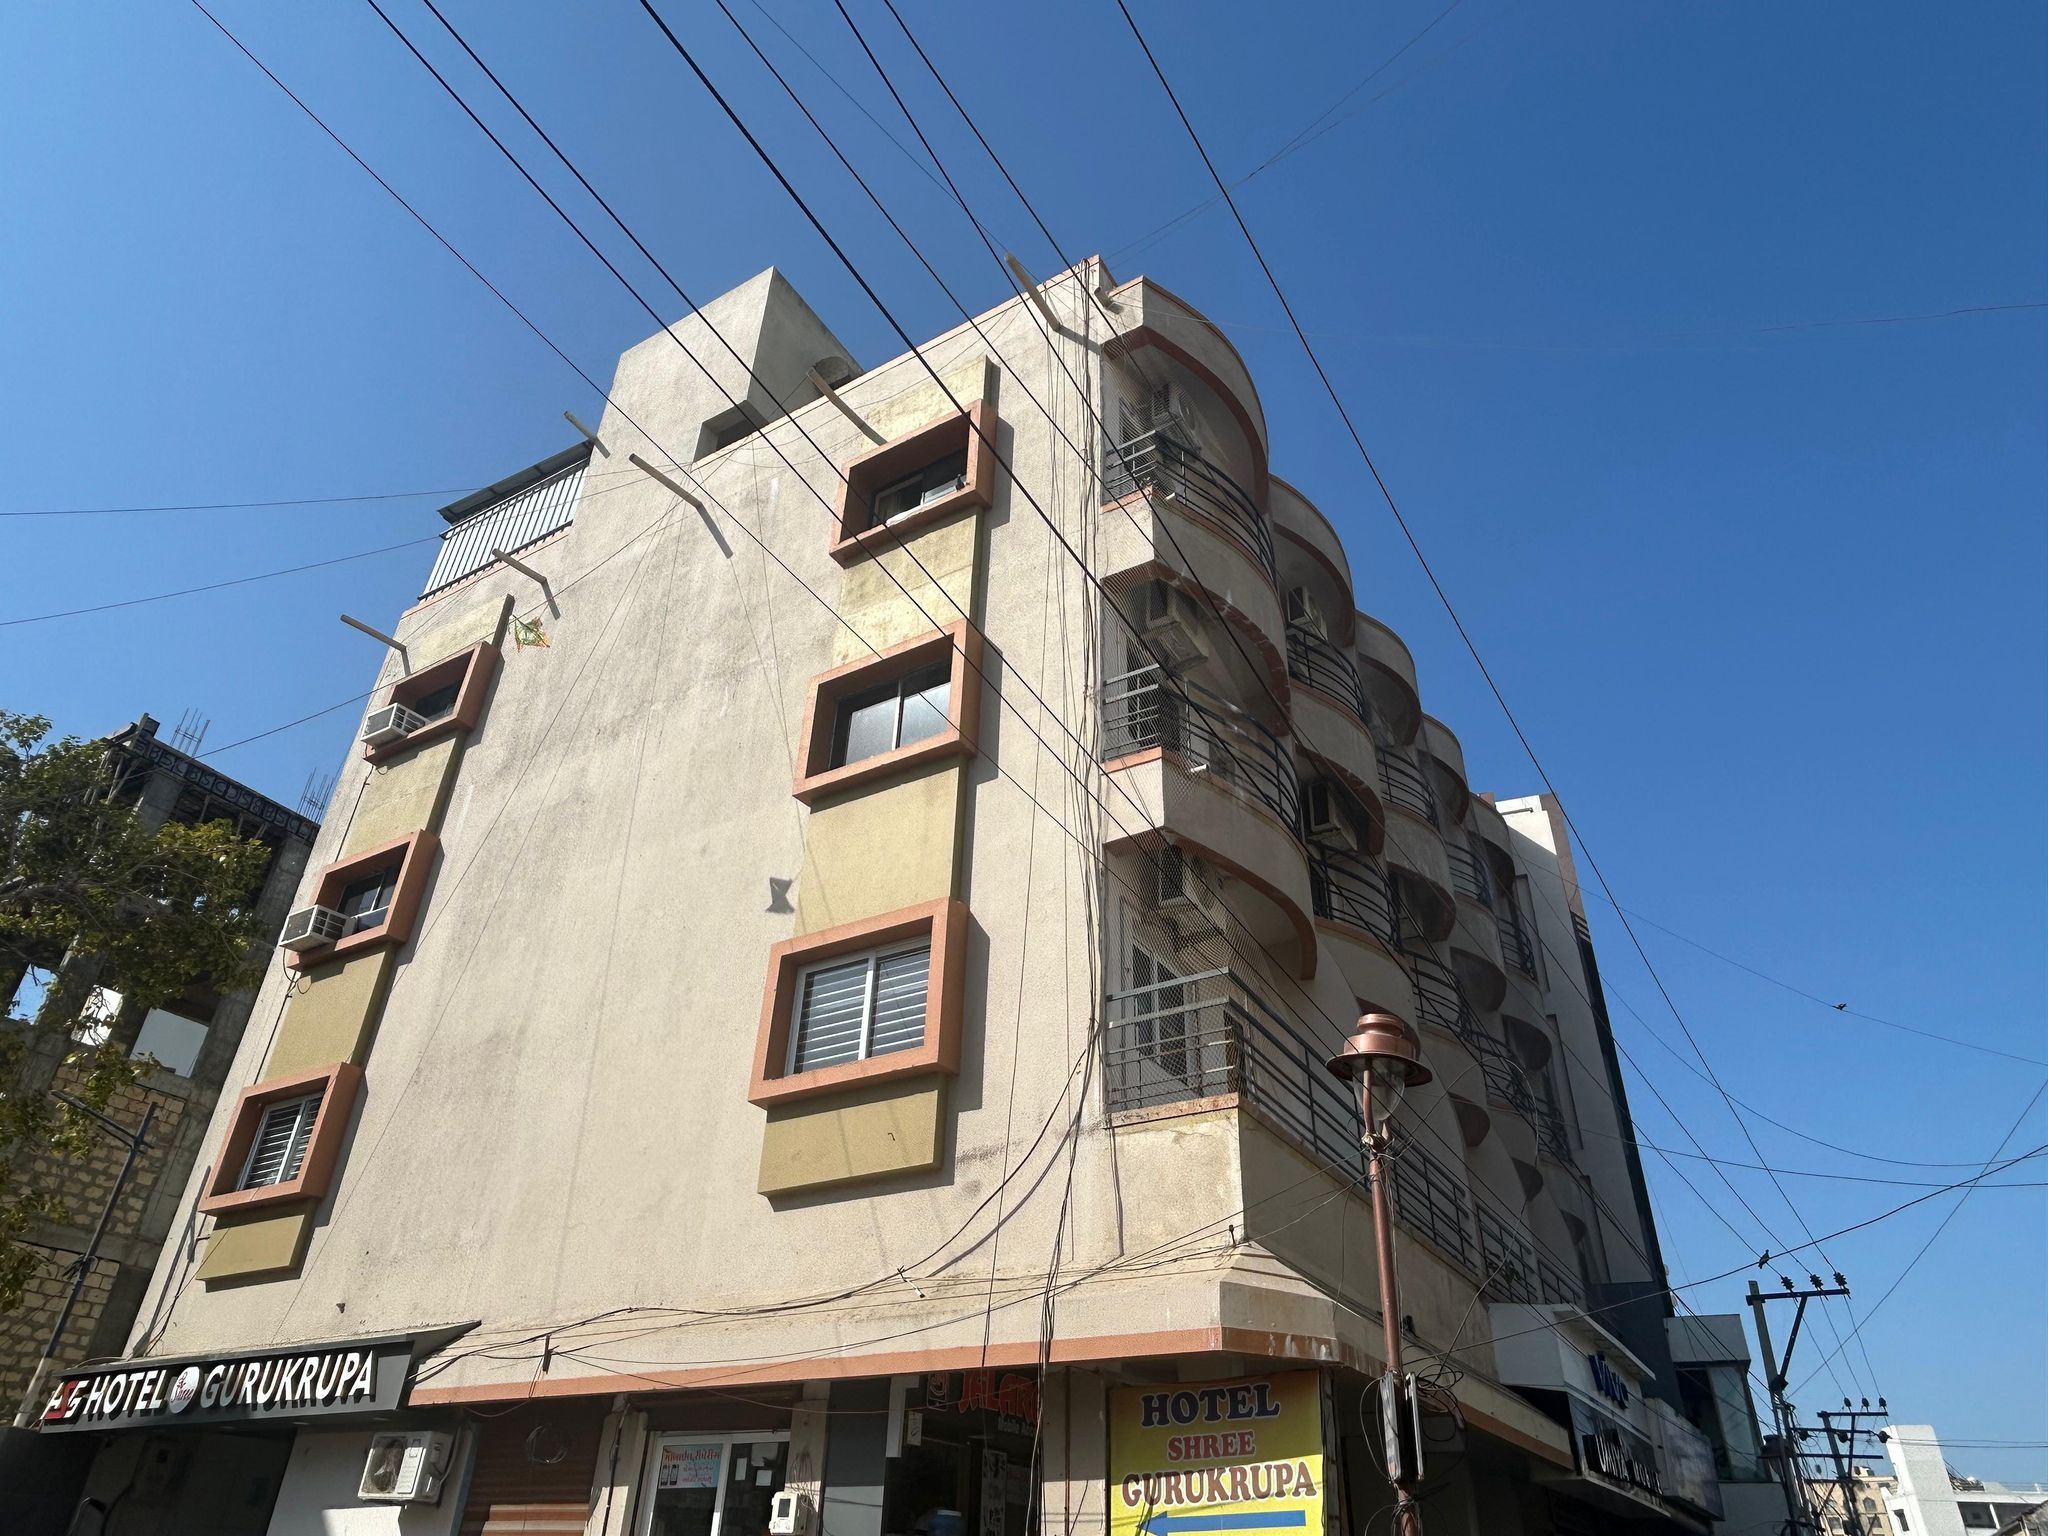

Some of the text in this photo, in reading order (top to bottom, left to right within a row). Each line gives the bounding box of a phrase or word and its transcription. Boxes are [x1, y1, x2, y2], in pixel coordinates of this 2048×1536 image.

[83, 1369, 167, 1415] HOTEL
[200, 1350, 373, 1409] GURUKRUPA
[1140, 1384, 1281, 1428] HOTEL
[1167, 1431, 1256, 1461] SHREE
[1121, 1461, 1318, 1507] GURUKRUPA
